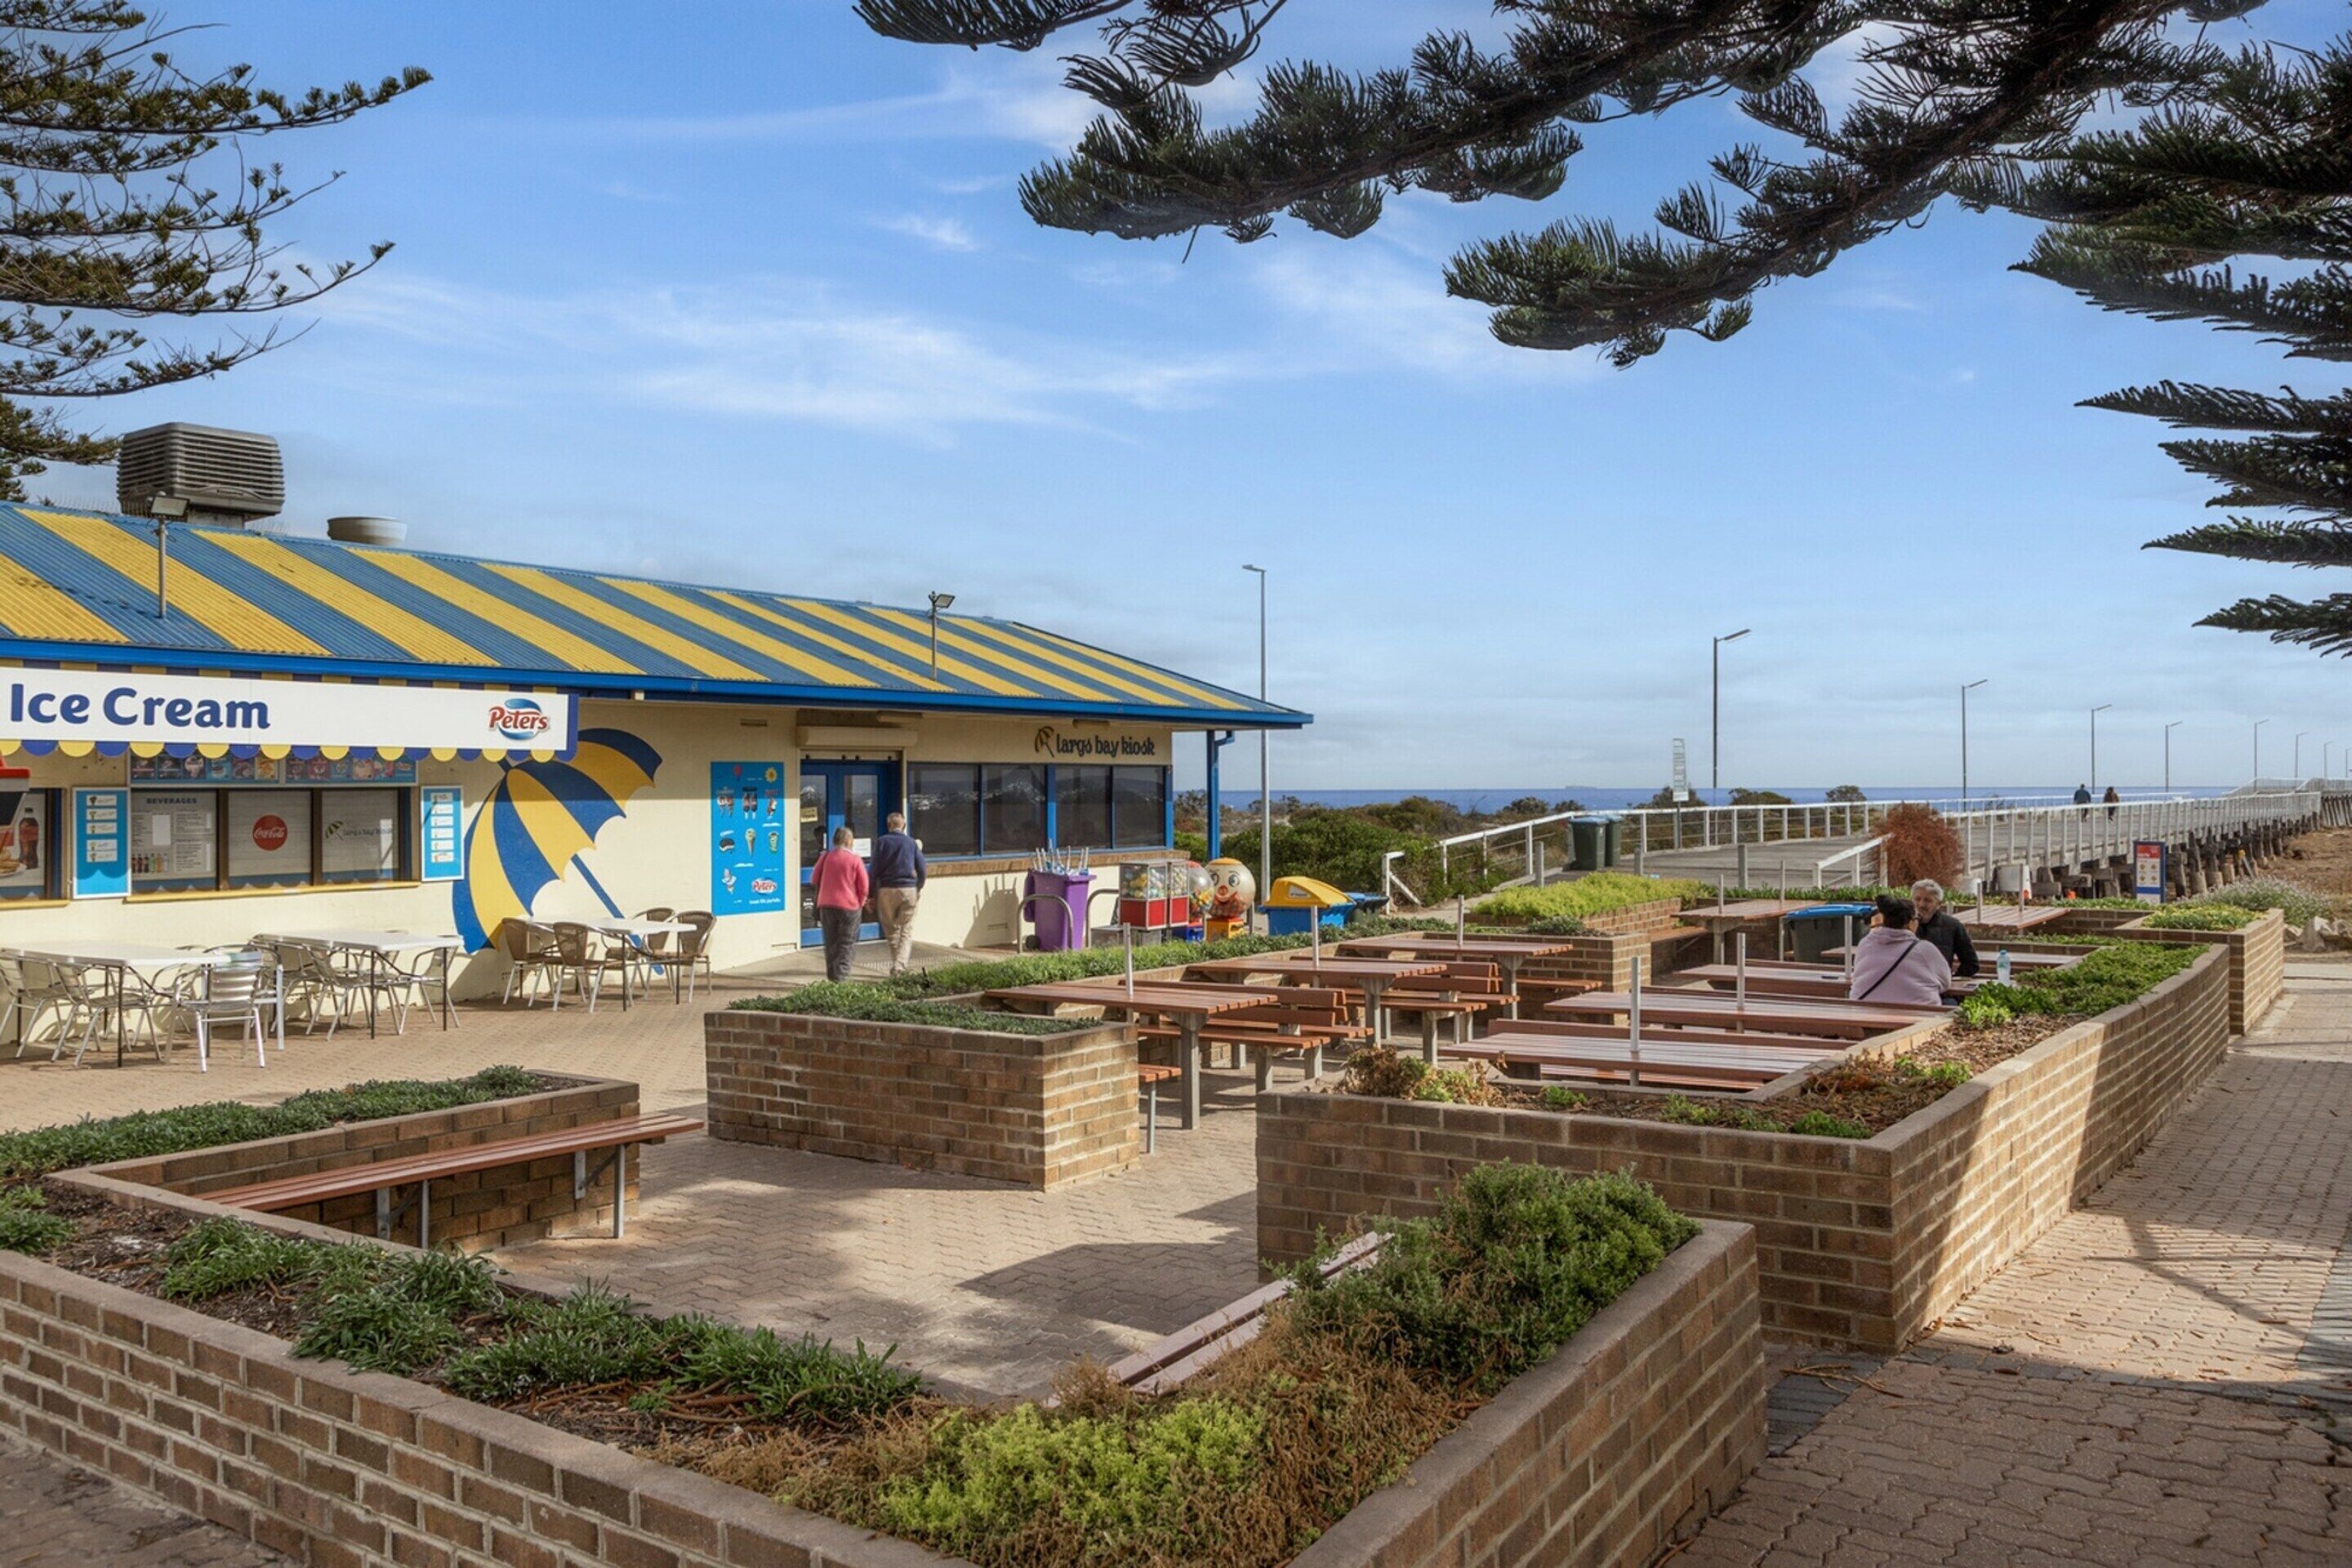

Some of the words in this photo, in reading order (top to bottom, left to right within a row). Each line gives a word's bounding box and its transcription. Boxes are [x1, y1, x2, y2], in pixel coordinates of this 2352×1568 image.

[11, 683, 91, 724] Ice
[103, 687, 271, 730] Cream
[488, 706, 548, 730] Peters
[1057, 733, 1093, 758] largs
[1095, 735, 1120, 758] bay
[1121, 735, 1156, 755] kiosk
